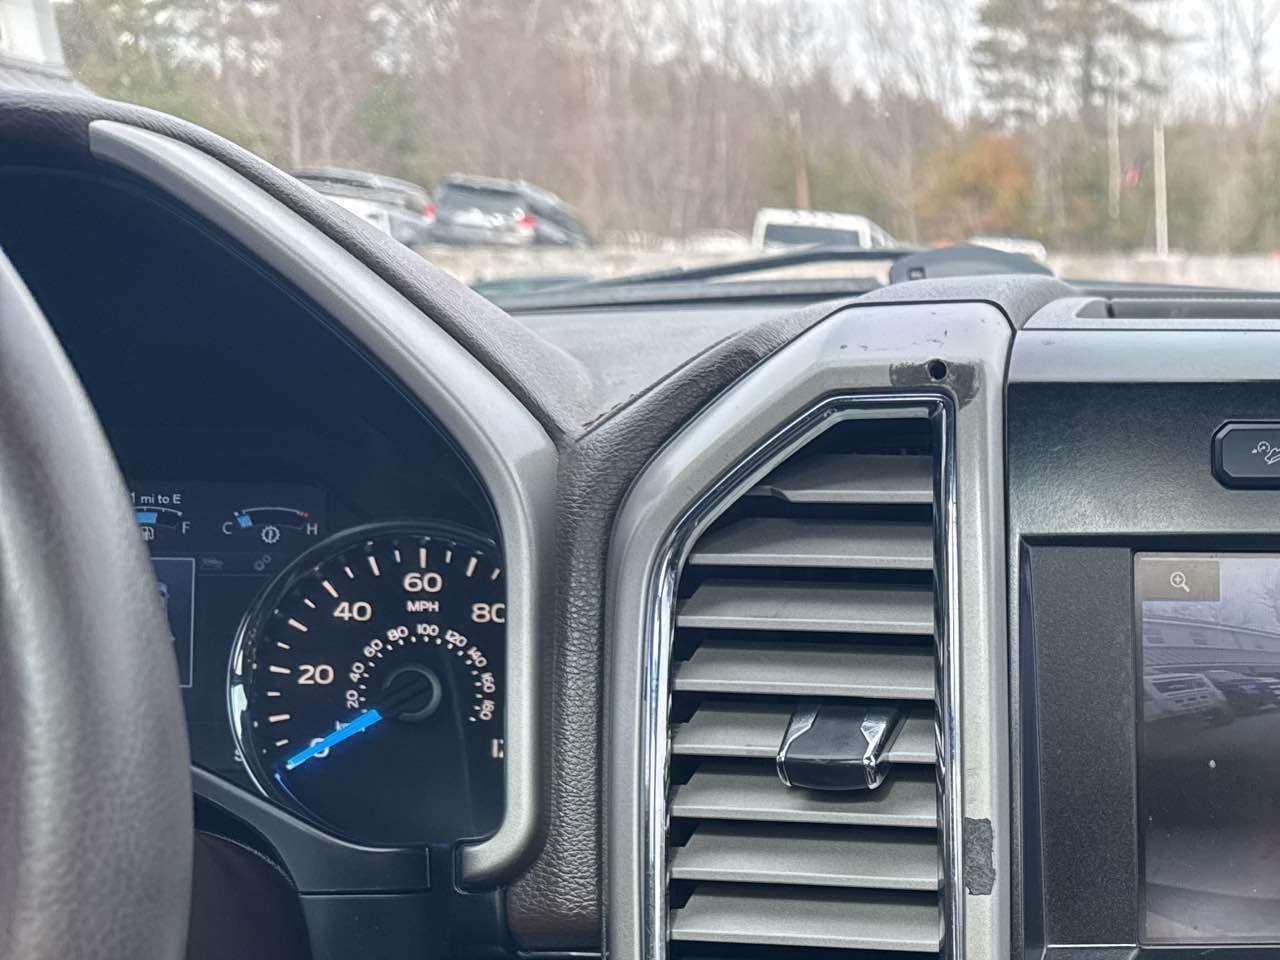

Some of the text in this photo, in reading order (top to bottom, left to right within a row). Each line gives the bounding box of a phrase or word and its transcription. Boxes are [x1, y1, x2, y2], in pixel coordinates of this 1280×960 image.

[141, 494, 155, 504] mi
[158, 494, 170, 504] to
[173, 494, 182, 504] E
[182, 522, 191, 534] F
[222, 522, 232, 535] C
[307, 523, 318, 535] H
[403, 572, 443, 593] 60
[333, 602, 373, 622] 40
[406, 601, 439, 613] MPH
[386, 625, 409, 641] 80
[416, 623, 440, 637] 100
[445, 629, 468, 648] 120
[363, 638, 384, 658] 60
[466, 646, 488, 668] 140
[298, 664, 334, 686] 20
[349, 661, 365, 683] 40
[480, 671, 496, 694] 160
[345, 689, 360, 709] 20
[480, 699, 496, 721] 180
